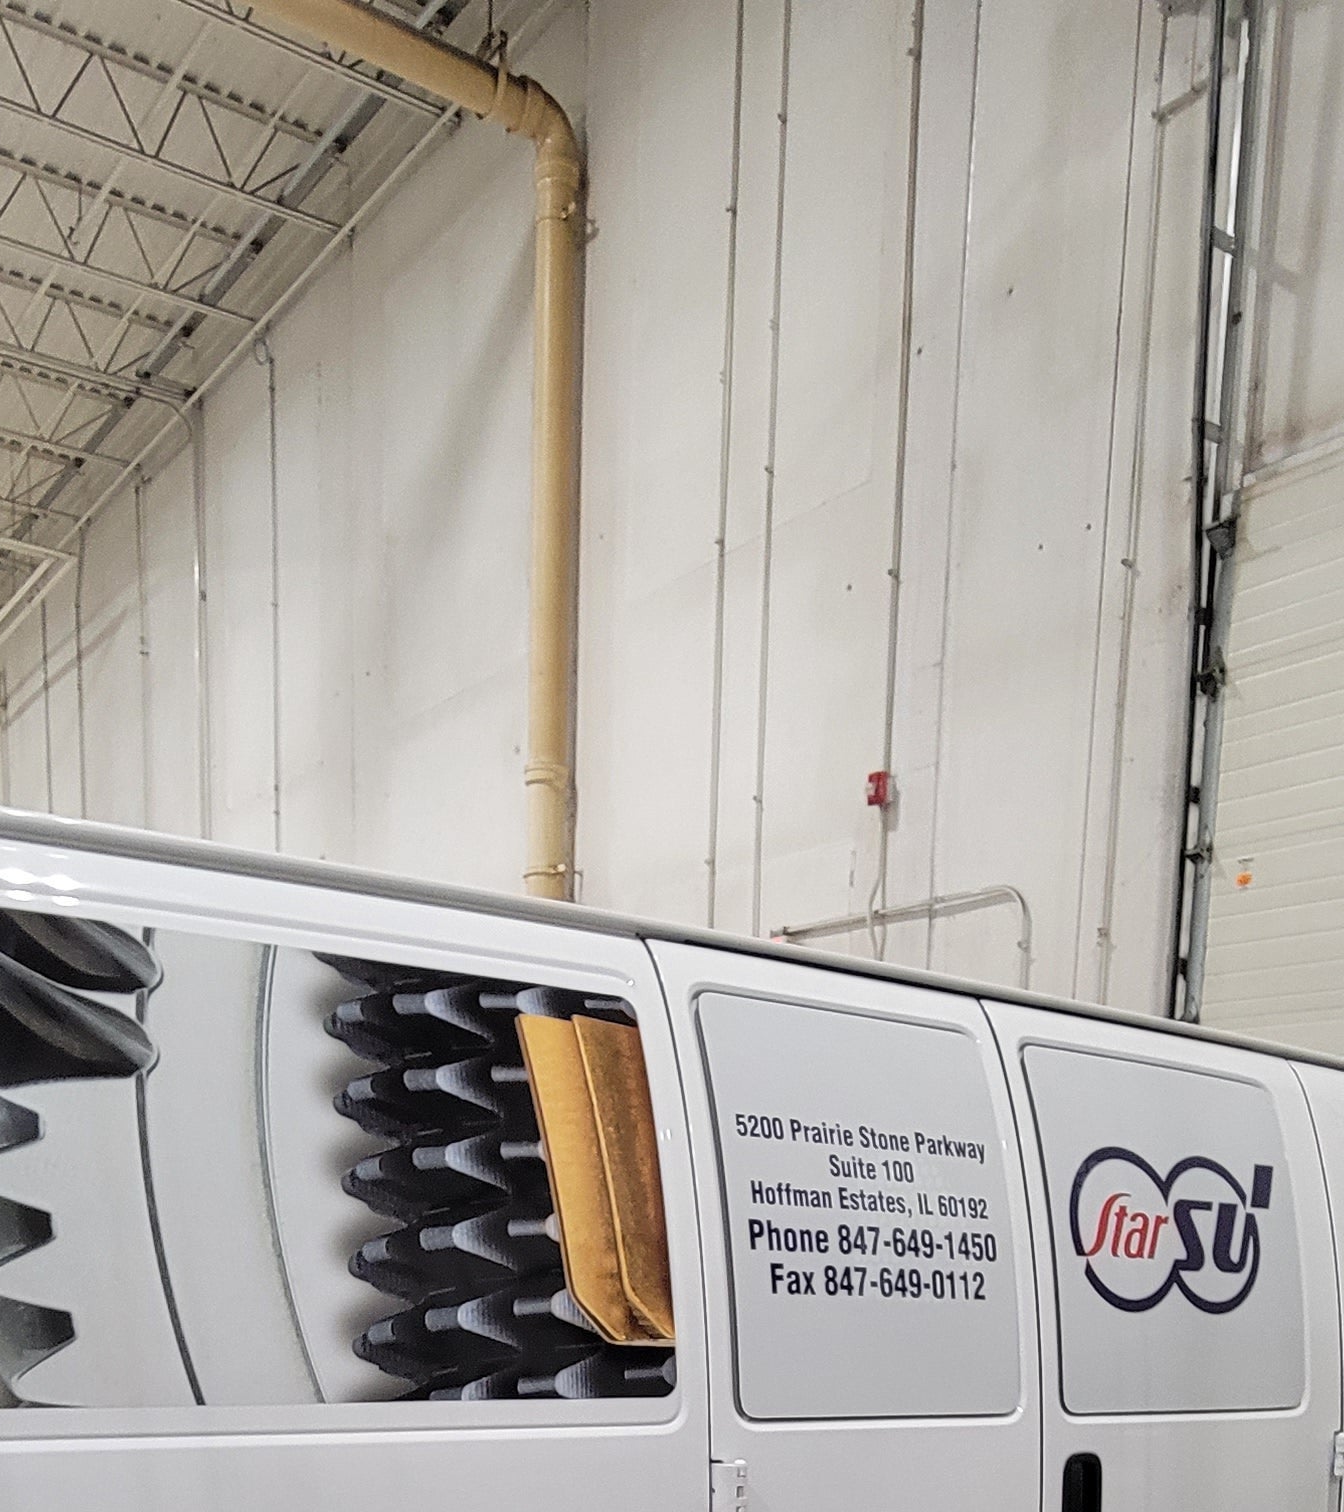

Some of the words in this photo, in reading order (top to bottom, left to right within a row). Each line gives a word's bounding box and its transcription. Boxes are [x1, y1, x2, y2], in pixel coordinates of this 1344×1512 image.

[735, 1113, 785, 1141] 5200
[789, 1118, 854, 1148] Prairie
[859, 1125, 910, 1153] Stone
[915, 1131, 986, 1164] Parkway
[829, 1154, 877, 1181] Suite
[882, 1158, 915, 1184] 100
[750, 1180, 834, 1211] Hoffman
[838, 1186, 914, 1217] Estates,
[918, 1193, 934, 1217] IL
[937, 1194, 989, 1220] 60192
[748, 1218, 830, 1255] Phone
[837, 1223, 997, 1263] 847-649-1450
[1086, 1192, 1169, 1260] Star
[770, 1262, 817, 1297] Fax
[823, 1264, 987, 1301] 847-649-0112
